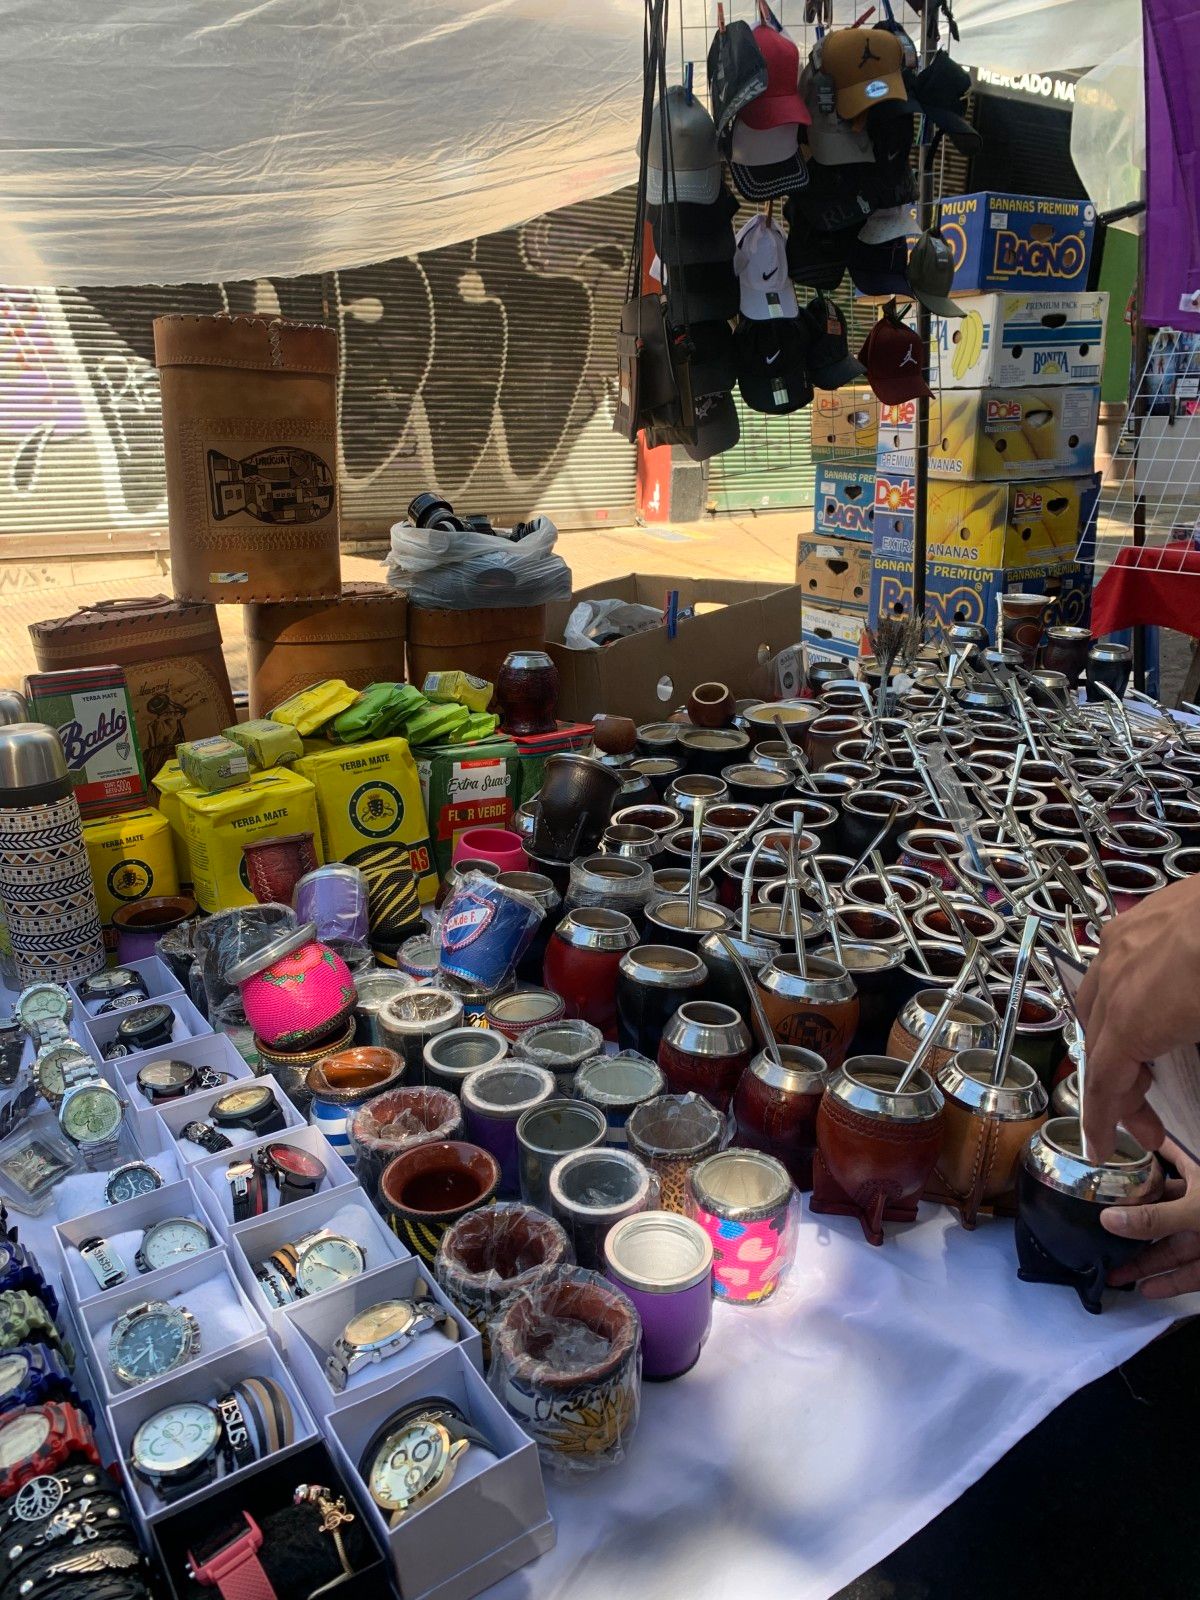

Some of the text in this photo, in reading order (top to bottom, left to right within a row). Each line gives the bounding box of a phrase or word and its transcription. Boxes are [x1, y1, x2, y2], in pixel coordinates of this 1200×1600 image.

[976, 67, 1053, 97] MERCADO
[941, 199, 977, 216] MIUM
[990, 198, 1079, 216] BANANAS PREMIUM
[993, 231, 1086, 279] BAGNO
[1025, 301, 1078, 310] PREMIUM PACK
[1033, 351, 1069, 375] BONITA
[987, 401, 1021, 418] Dole
[928, 457, 962, 473] NANAS
[824, 470, 856, 481] BANANAS
[875, 478, 916, 509] Dole
[1015, 492, 1043, 508] Dole
[927, 544, 979, 560] ANANAS
[875, 558, 929, 575] BANANS
[933, 565, 994, 584] PREMIUM
[1007, 562, 1081, 582] BANANAS PREMIUM
[102, 692, 117, 700] MATE
[58, 707, 128, 763] Baldo
[339, 759, 368, 772] YERBA
[368, 753, 390, 766] MATE
[447, 774, 511, 796] Extra Suave
[231, 815, 262, 829] YERBA
[263, 807, 289, 822] MATE
[477, 803, 507, 819] VERDE
[101, 839, 125, 849] YERBA
[125, 834, 145, 843] MATE
[92, 1248, 119, 1278] Jesus
[218, 1399, 247, 1452] JESUS
